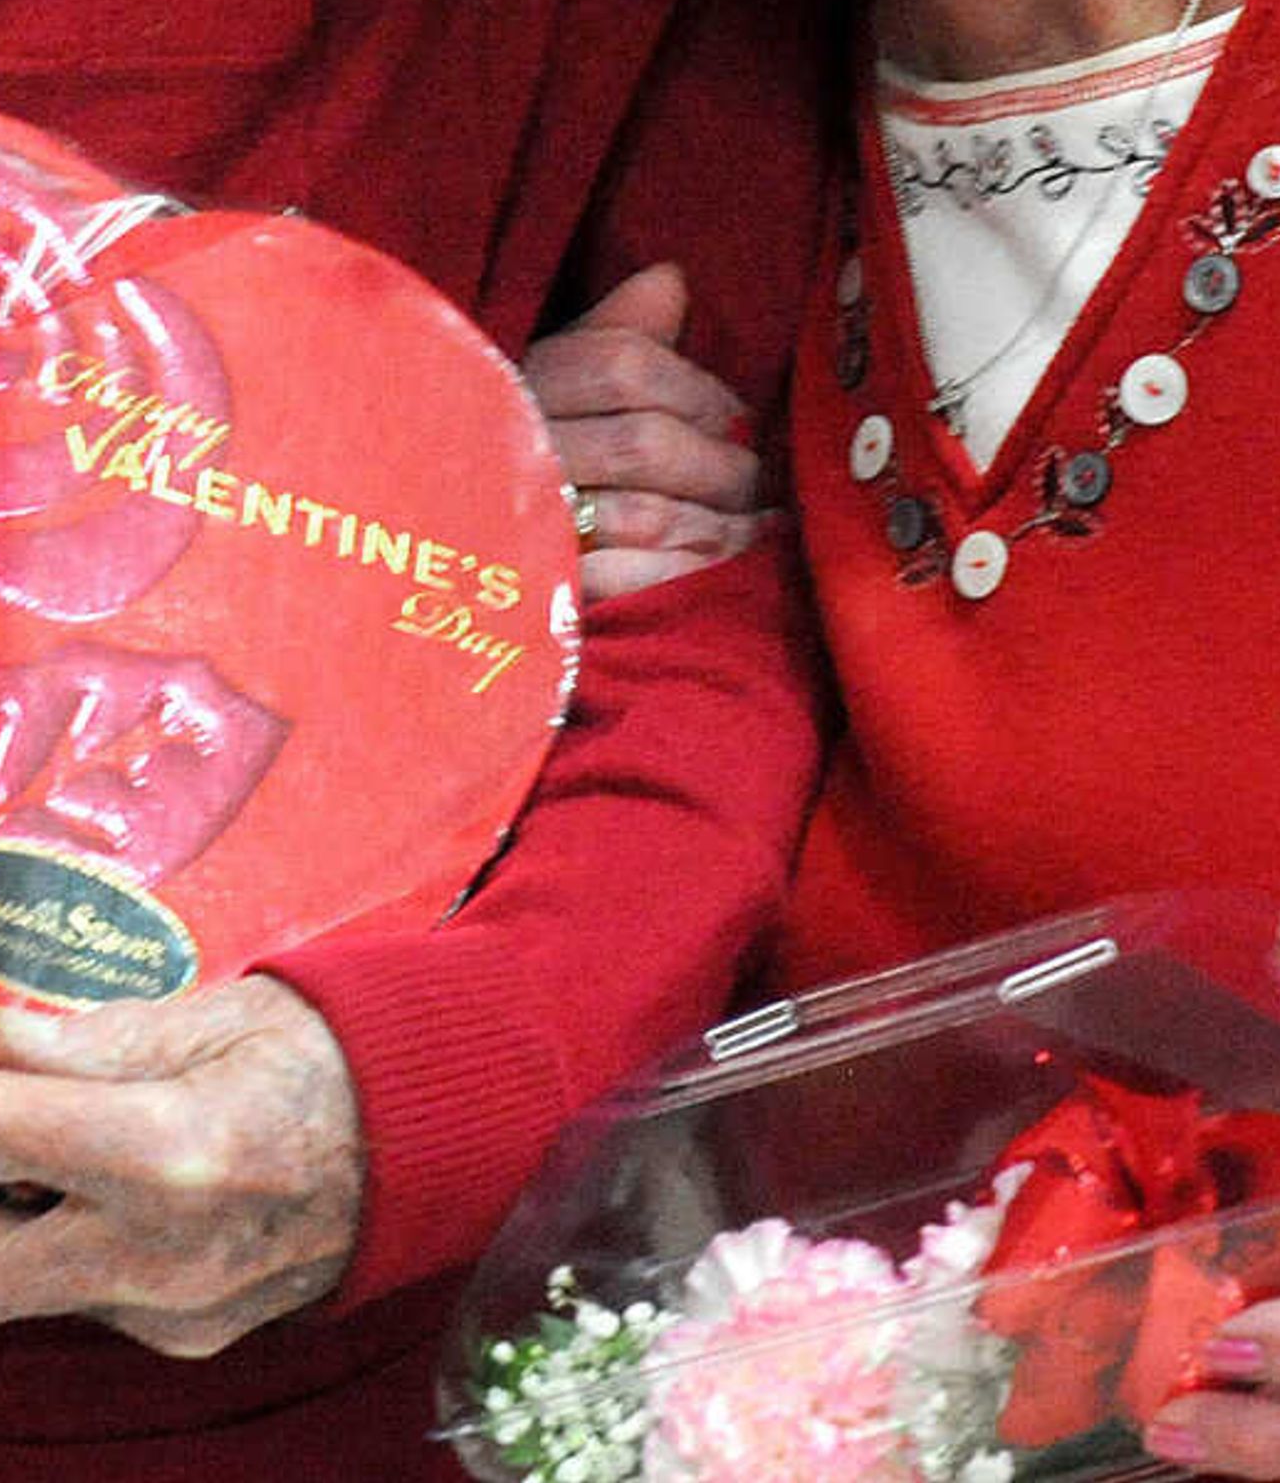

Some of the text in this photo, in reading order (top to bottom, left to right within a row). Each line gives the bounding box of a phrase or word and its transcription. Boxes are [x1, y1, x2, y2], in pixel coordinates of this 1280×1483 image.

[39, 352, 230, 471] Happy
[65, 424, 521, 610] VALENTINE'S
[391, 592, 524, 693] Day
